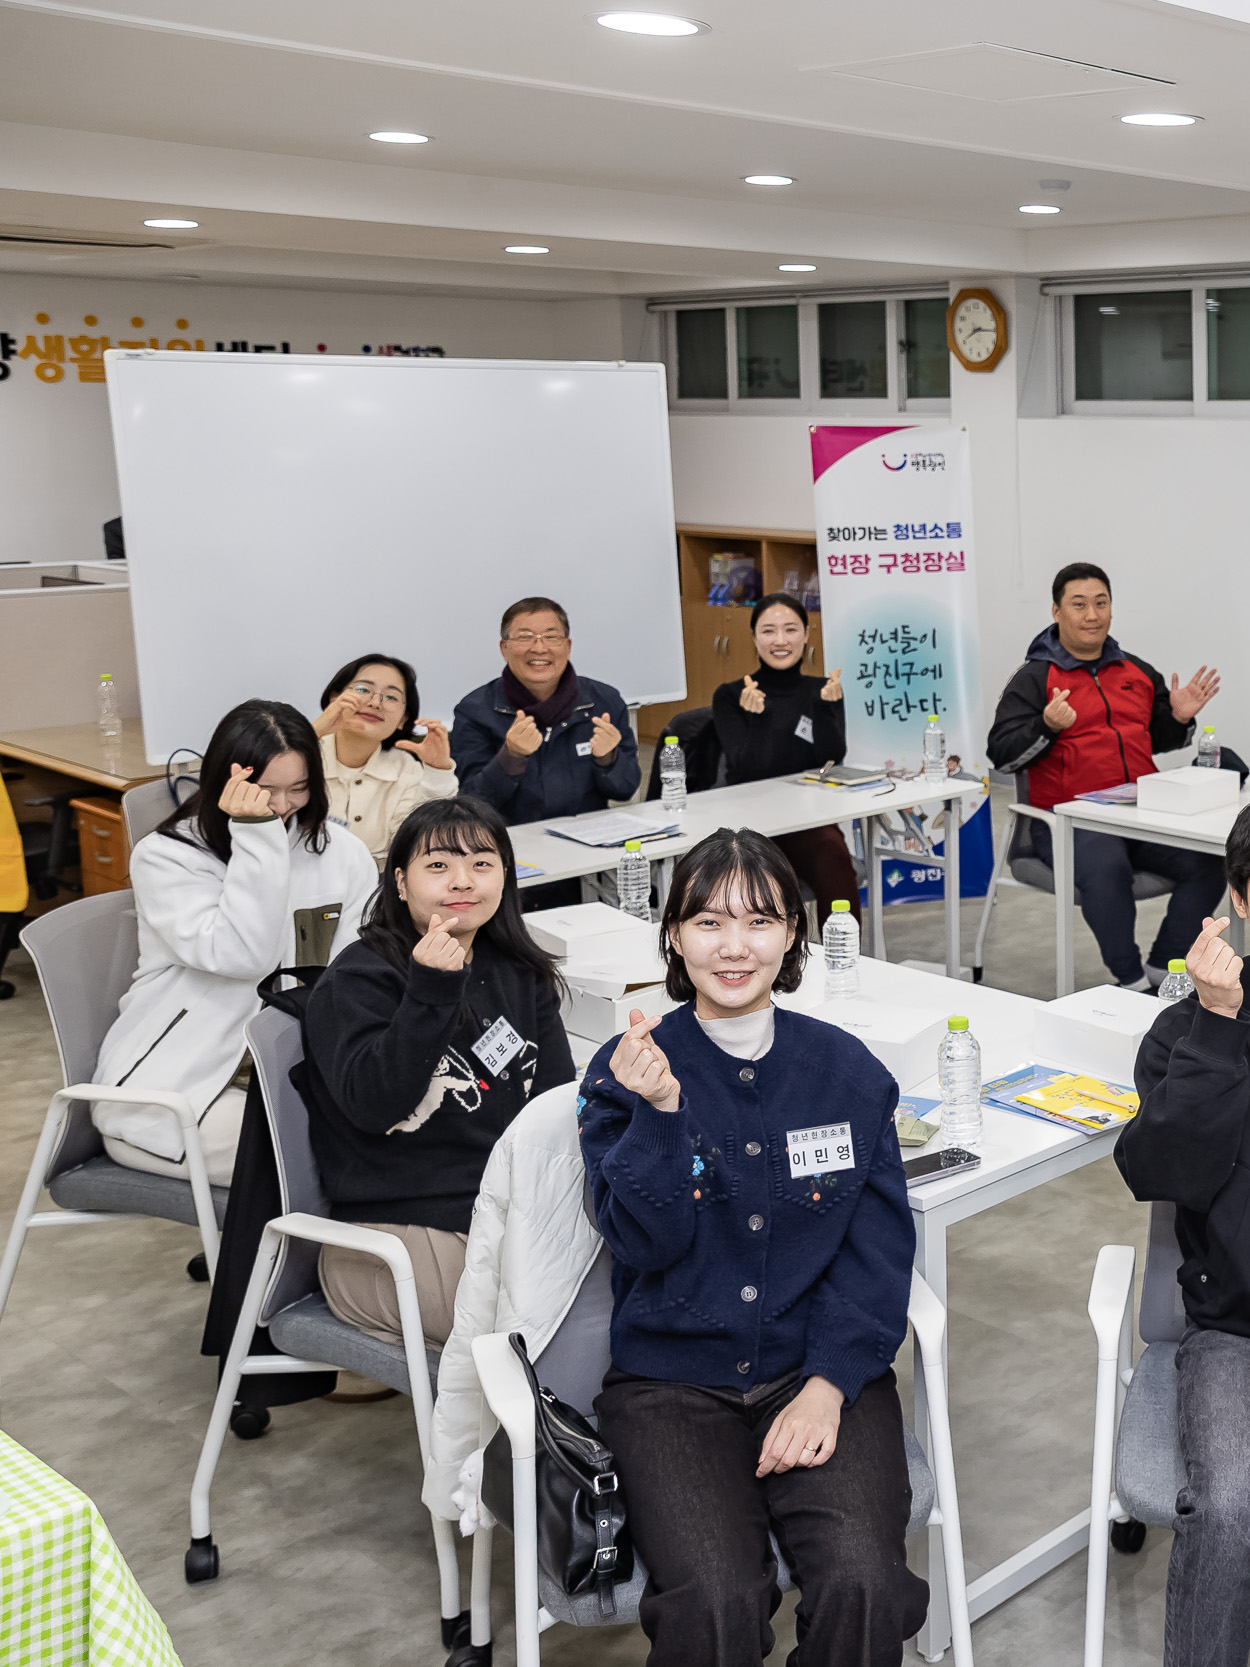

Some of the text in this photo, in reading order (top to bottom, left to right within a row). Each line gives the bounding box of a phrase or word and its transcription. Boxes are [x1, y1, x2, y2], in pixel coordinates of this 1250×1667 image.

[827, 522, 962, 542] 찾아가는 청년소통
[827, 551, 966, 576] 현장 구청장실
[858, 624, 937, 655] 청년들이
[856, 658, 943, 689] 광진구에
[864, 691, 948, 722] 바란다.
[910, 868, 946, 883] 광진
